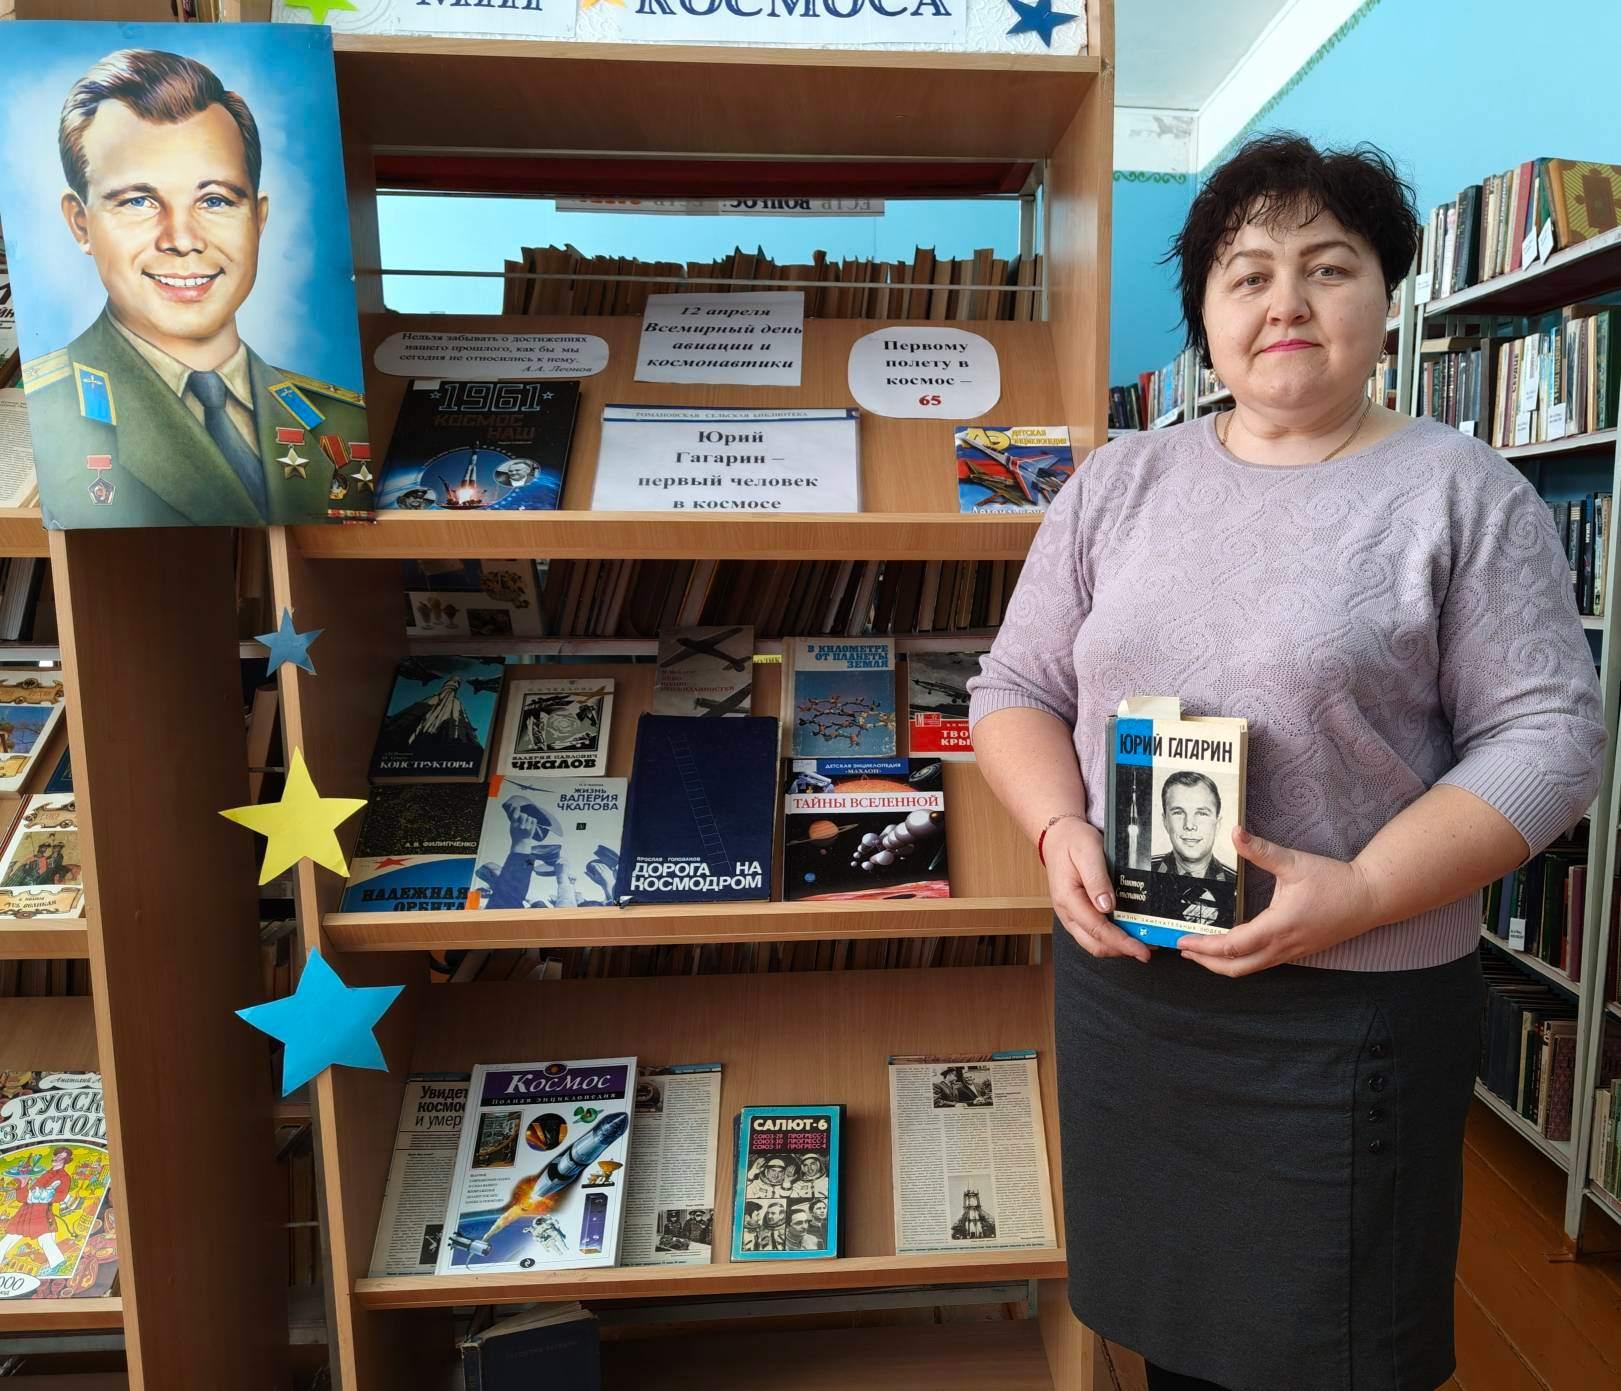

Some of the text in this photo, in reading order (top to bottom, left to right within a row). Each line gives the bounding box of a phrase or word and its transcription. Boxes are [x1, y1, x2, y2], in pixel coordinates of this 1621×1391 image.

[680, 306, 771, 318] 12 апреля
[644, 322, 803, 336] Всемирный день
[401, 332, 443, 342] Нельзя
[404, 344, 448, 352] нашего
[452, 345, 513, 354] прошлого,
[539, 345, 555, 353] бы
[672, 341, 771, 352] авиации и
[883, 340, 968, 353] Первому
[399, 354, 445, 363] сегодня
[466, 355, 533, 363] относились
[647, 359, 794, 369] космонавтики
[885, 360, 969, 370] полету в
[886, 377, 954, 385] космос
[438, 383, 541, 411] 1961
[919, 395, 942, 406] 65
[434, 414, 524, 427] КОСМОС
[487, 427, 535, 440] НАШ
[697, 430, 764, 446] Юрий
[676, 452, 766, 466] Гагарин
[638, 475, 819, 489] первый человек
[673, 500, 782, 509] в космосе
[808, 644, 888, 653] В КИЛОМЕТРЕ
[815, 652, 888, 662] ОТ ПЛАНЕТЫ
[847, 660, 888, 669] ЗЕМЛЯ
[940, 730, 968, 738] ТВО
[940, 738, 971, 746] КРЫ
[1119, 733, 1233, 763] ЮРИЙ ГАГАРИН
[379, 760, 475, 769] КОНСТРУКТОРЫ
[511, 759, 597, 771] ЧКАЛОВ
[560, 793, 618, 803] ВАЛЕРИЯ
[793, 794, 939, 809] ТАЙНЫ ВСЕЛЕННОЙ
[557, 802, 619, 811] ЧКАЛОВА
[631, 860, 763, 878] ДОРОГА НА
[630, 874, 763, 892] КОСМОДРОМ
[361, 886, 469, 902] НАДЕЖНАЯ
[420, 1085, 468, 1101] Увидет
[536, 1093, 617, 1104] ЭНЦИКЛОПЕДИЯ
[19, 1091, 102, 1119] РУССК
[415, 1115, 462, 1130] и умер
[753, 1119, 828, 1131] САЛЮТ-6
[0, 1114, 107, 1145] ЗАСТОЛ
